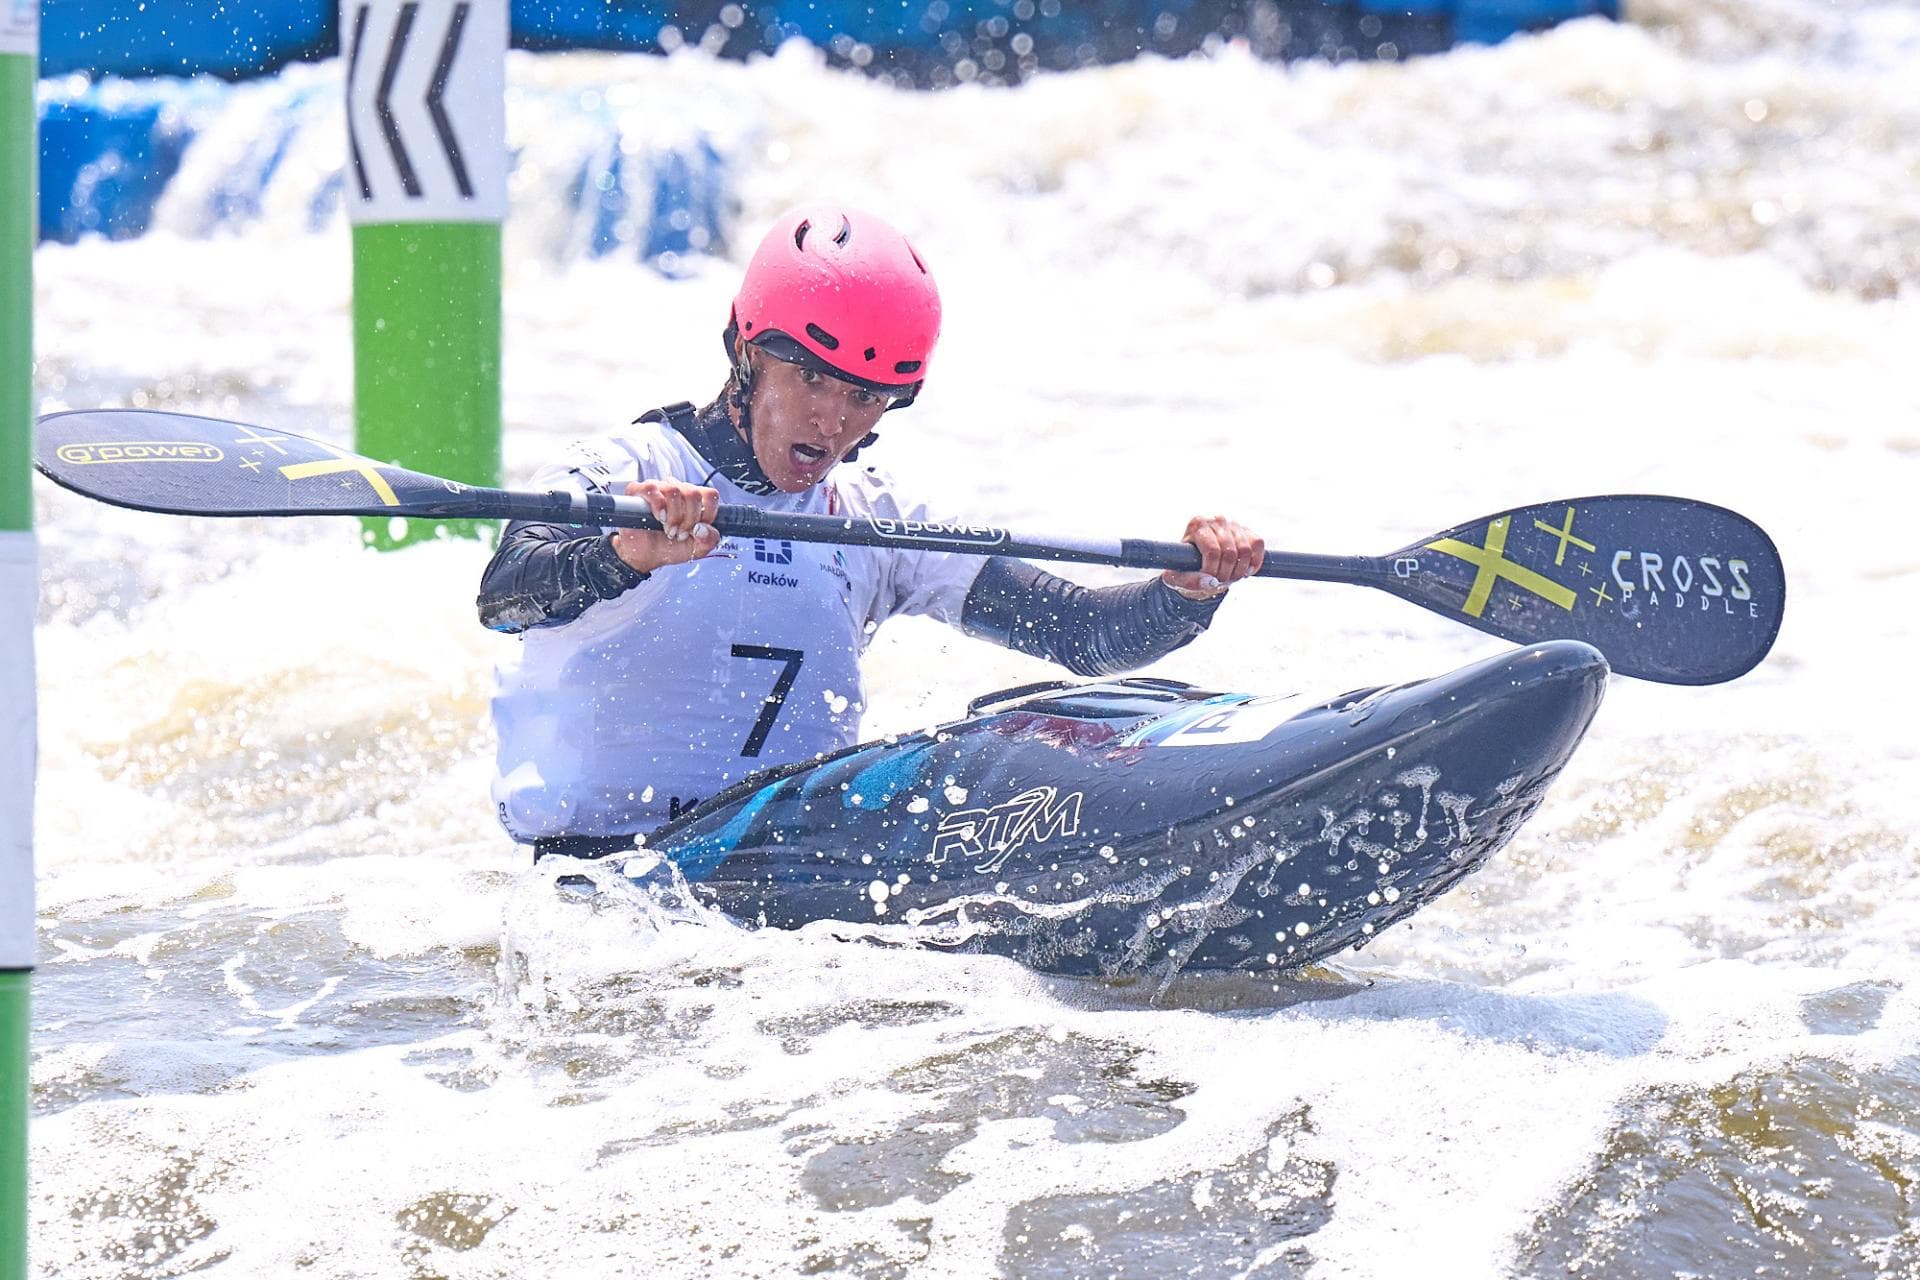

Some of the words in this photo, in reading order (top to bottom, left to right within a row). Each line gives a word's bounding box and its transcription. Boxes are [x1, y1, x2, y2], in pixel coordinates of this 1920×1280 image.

[747, 571, 799, 589] Kraków
[1611, 550, 1750, 600] CROSS
[1622, 589, 1759, 618] PADDLE
[731, 643, 804, 757] 7
[931, 787, 1083, 872] RTM
